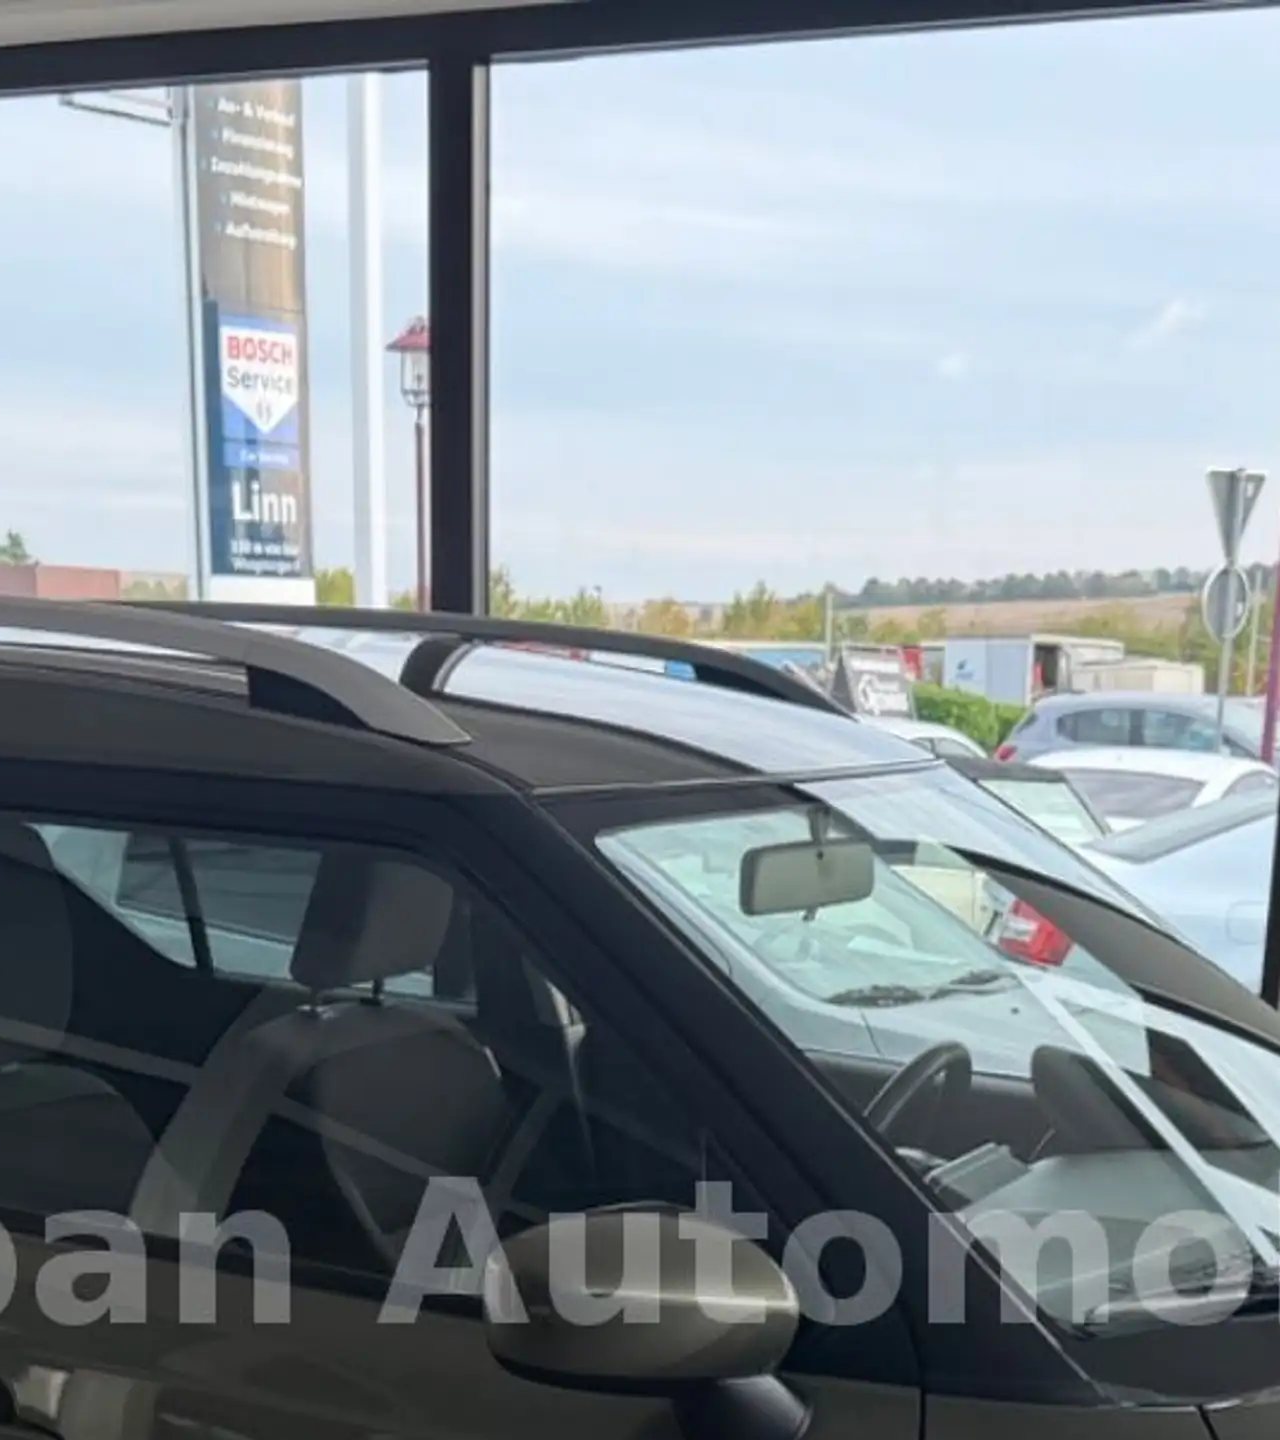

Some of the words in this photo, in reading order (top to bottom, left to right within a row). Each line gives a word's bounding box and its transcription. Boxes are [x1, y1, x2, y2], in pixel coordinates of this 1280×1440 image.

[226, 335, 293, 366] BOSCH
[226, 365, 293, 395] Service
[231, 480, 297, 524] Linn
